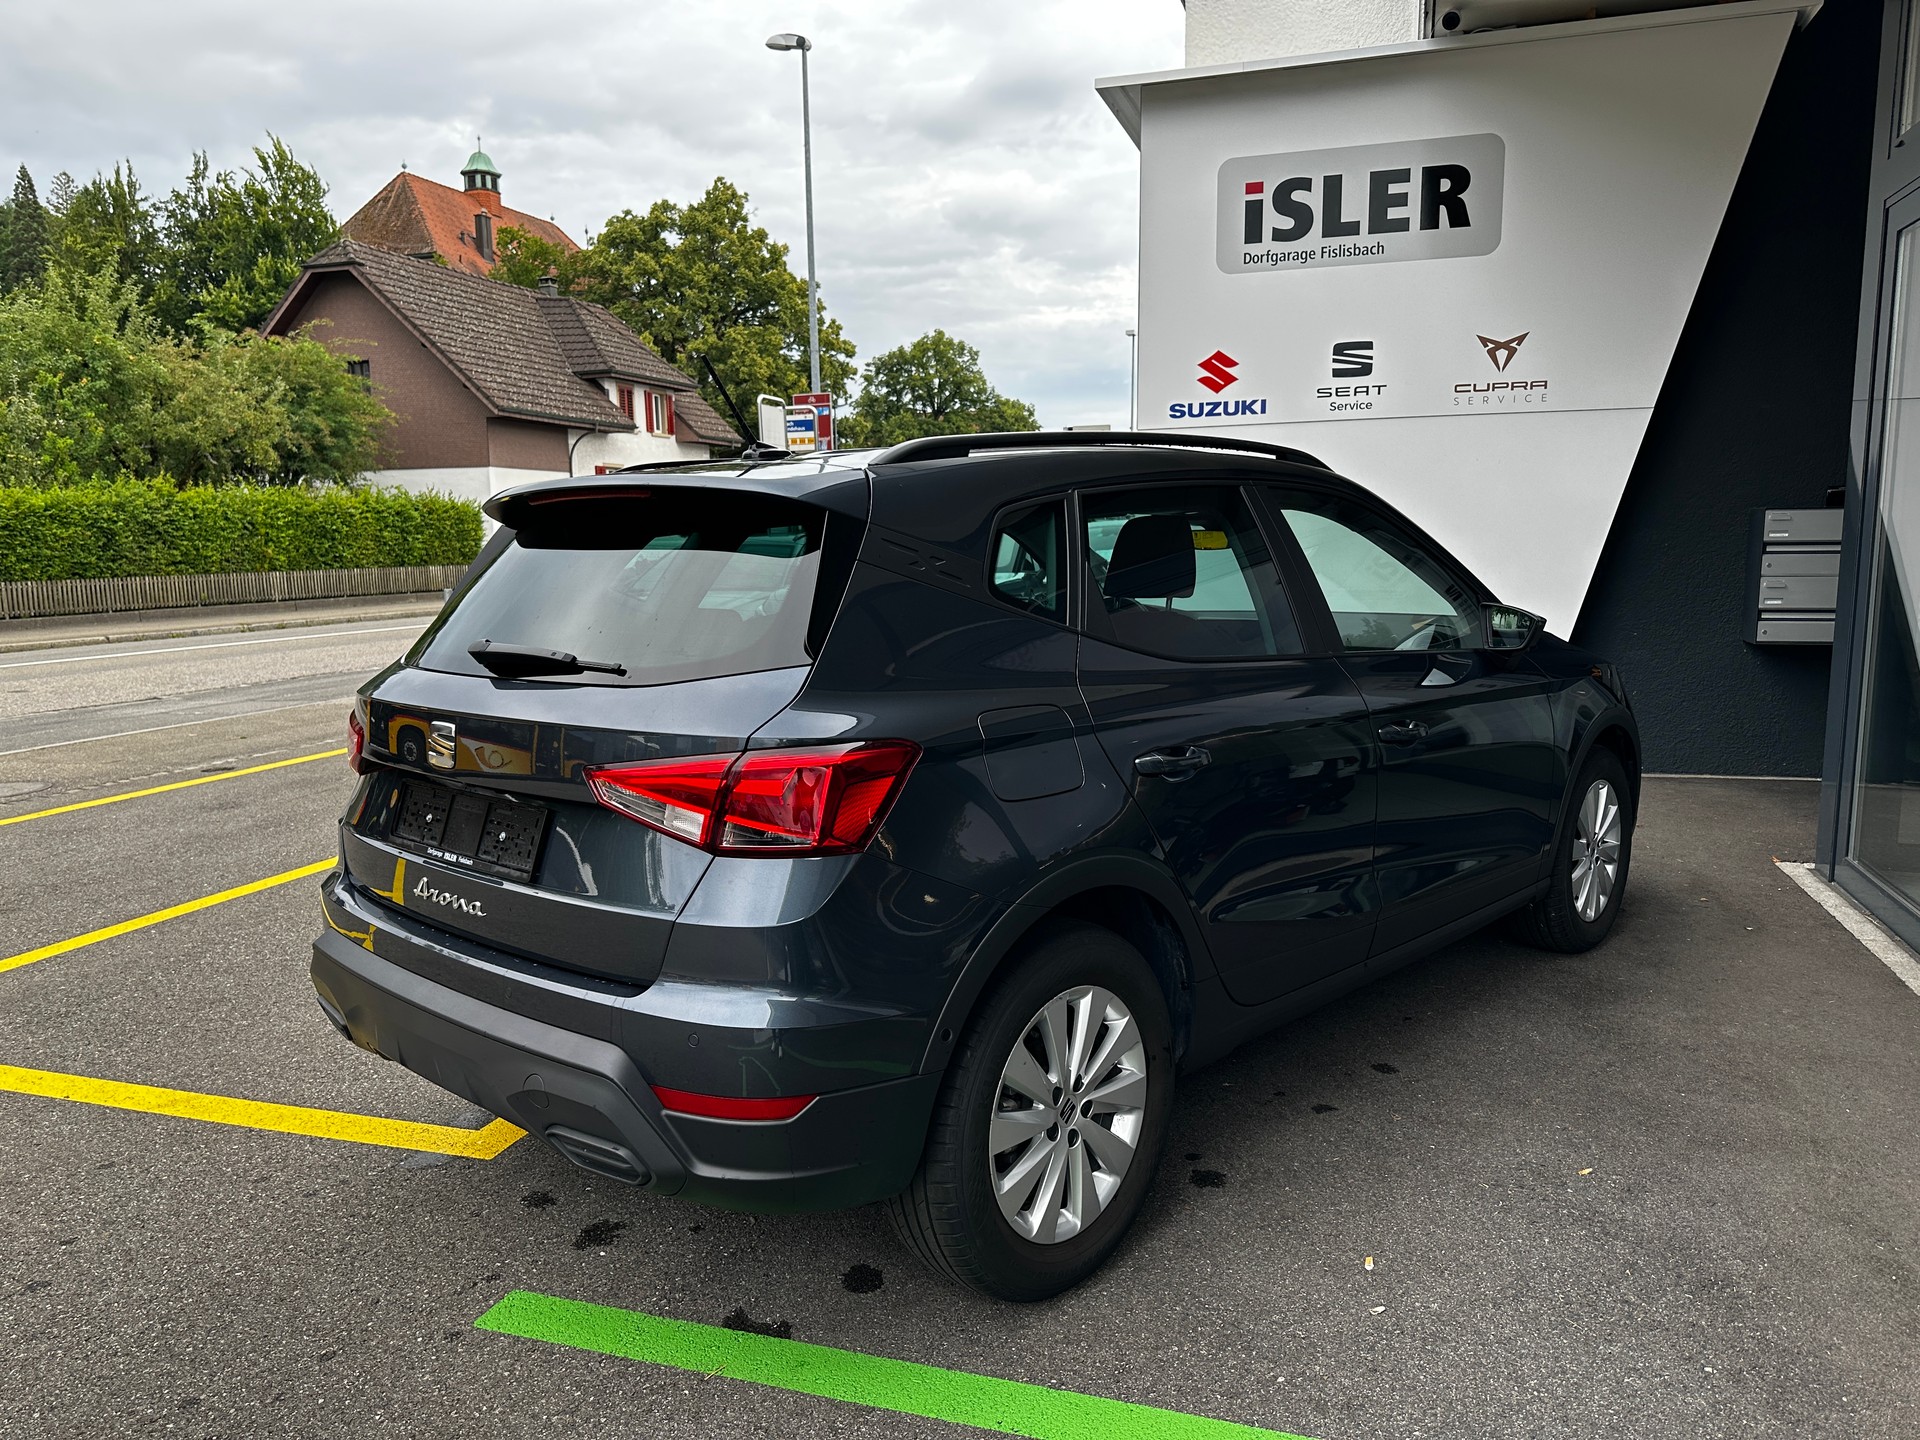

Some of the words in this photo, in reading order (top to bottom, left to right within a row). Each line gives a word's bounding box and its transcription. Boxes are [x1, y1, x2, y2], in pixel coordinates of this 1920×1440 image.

[1243, 249, 1316, 266] Dorfgarage
[1320, 241, 1385, 259] Fislisbach
[1316, 384, 1388, 399] SEAT
[1454, 380, 1548, 393] CUPRA
[1329, 400, 1373, 412] Service
[1453, 393, 1548, 406] SERVICE
[1168, 398, 1267, 419] SUZUKI
[413, 876, 487, 917] Arona
